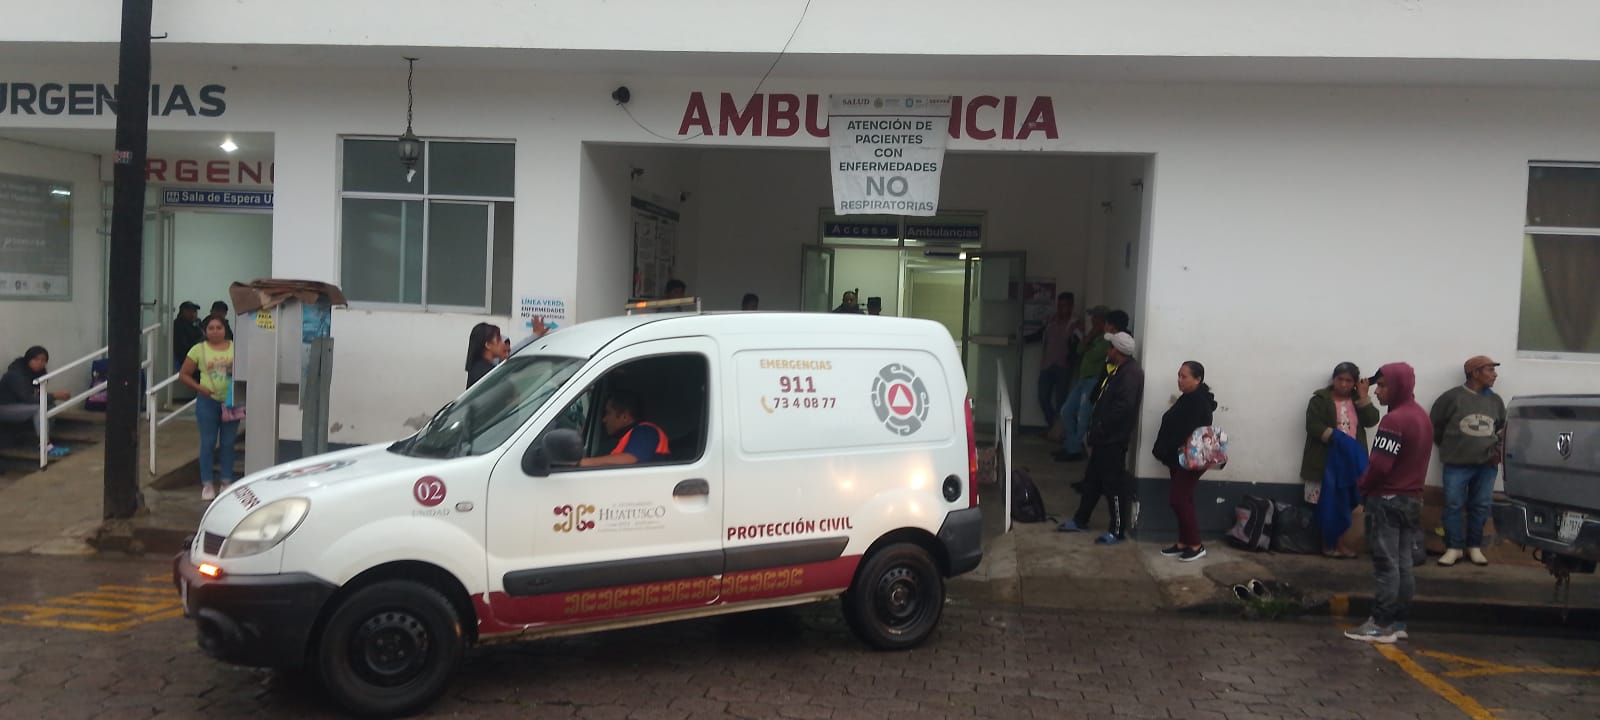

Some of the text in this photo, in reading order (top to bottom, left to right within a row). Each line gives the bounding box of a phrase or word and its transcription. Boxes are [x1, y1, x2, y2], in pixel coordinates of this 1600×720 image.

[0, 82, 227, 117] RGENIAS
[678, 91, 1059, 140] AMBUCIA
[847, 118, 933, 131] ATENCIÓN DE
[855, 134, 923, 145] PACIENTES
[874, 147, 903, 158] CON
[145, 158, 274, 184] RGEN
[839, 161, 938, 172] ENFERMEDADES
[865, 175, 909, 198] NO
[181, 191, 274, 205] Sala de Espera U
[840, 200, 934, 211] RESPIRATORIAS
[831, 224, 979, 238] Acceso Ambulancias
[760, 359, 832, 370] EMERGENCIAS
[779, 376, 816, 393] 911
[773, 397, 836, 409] 73 4 08 77
[417, 481, 443, 501] 02
[599, 505, 666, 521] HUATUSCO
[727, 516, 853, 541] PROTECCIÓN CIVIL
